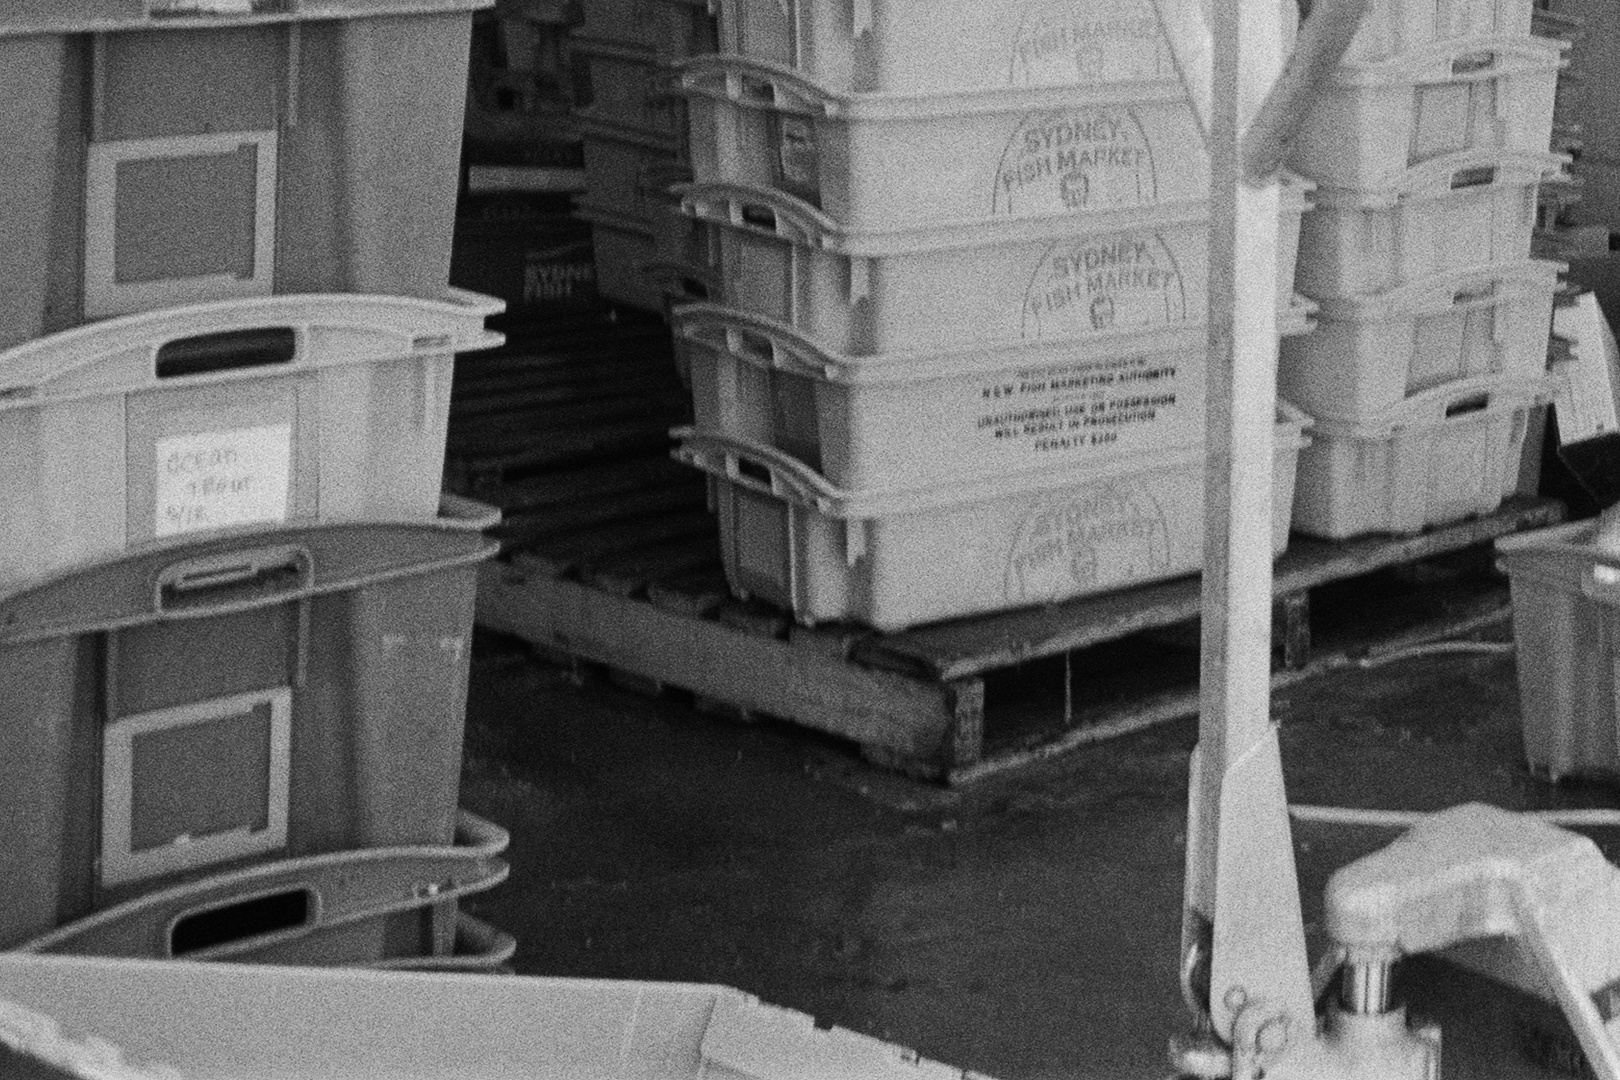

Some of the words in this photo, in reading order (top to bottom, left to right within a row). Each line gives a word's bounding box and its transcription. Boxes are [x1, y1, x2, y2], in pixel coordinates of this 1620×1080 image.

[1024, 116, 1122, 154] SYDNEY
[1003, 157, 1052, 193] FISH
[1057, 148, 1145, 172] MARKET
[524, 263, 592, 282] SYDNE
[1051, 241, 1147, 279] SYDNEY
[1031, 281, 1081, 317] FISH
[1086, 268, 1177, 296] MARKET
[1050, 372, 1114, 390] MARKETING
[1084, 408, 1157, 428] PROSECUTION
[1033, 434, 1085, 451] PENALTY
